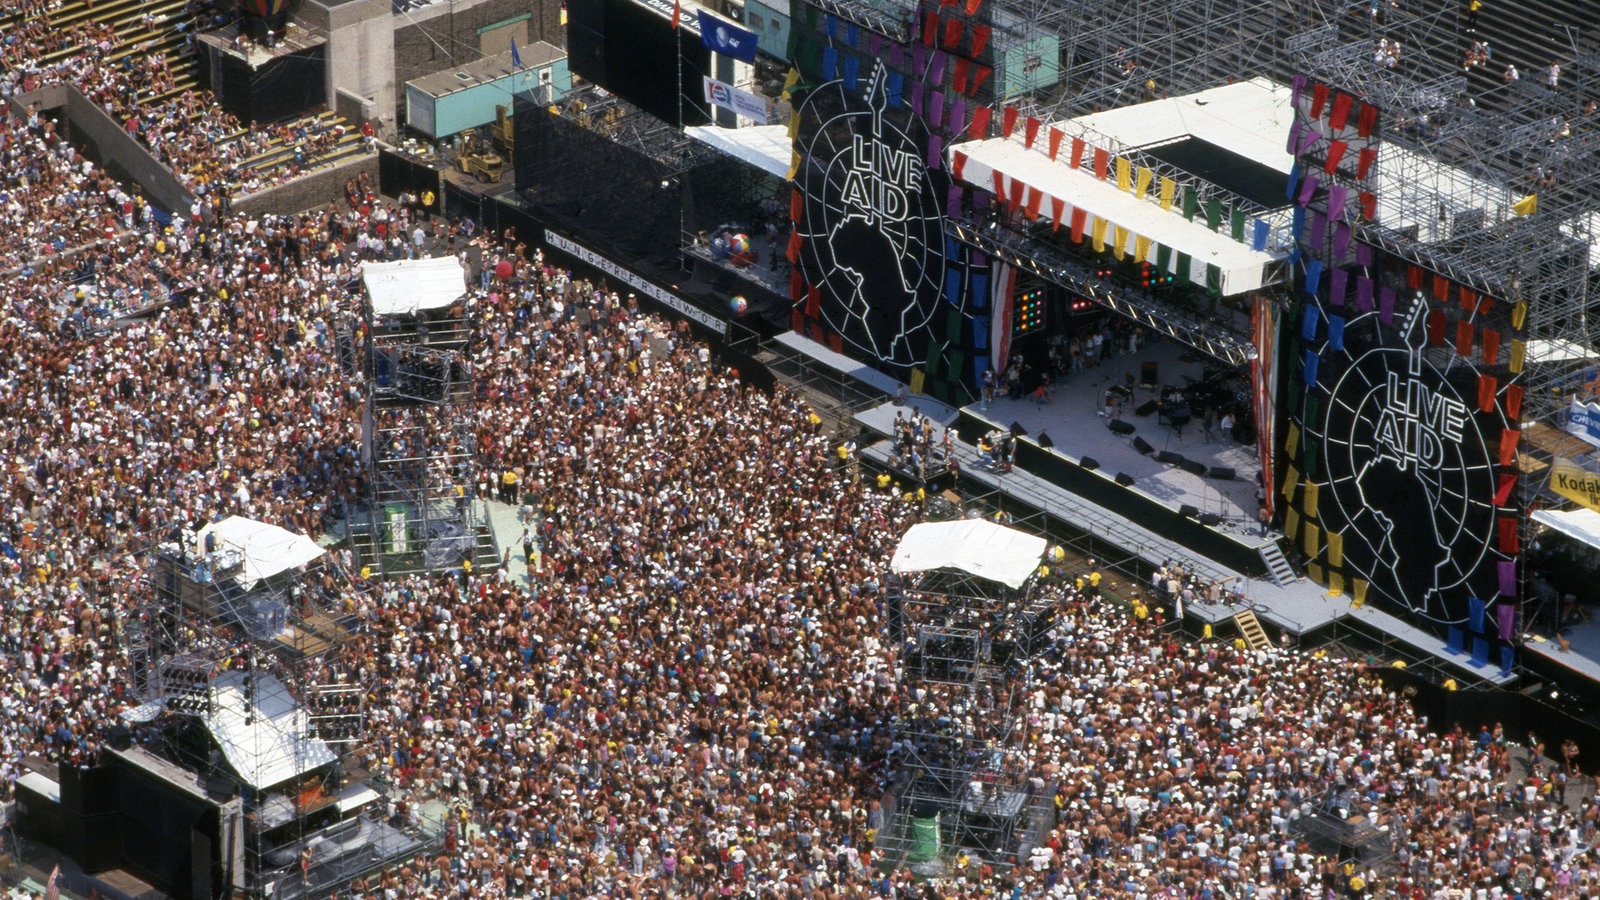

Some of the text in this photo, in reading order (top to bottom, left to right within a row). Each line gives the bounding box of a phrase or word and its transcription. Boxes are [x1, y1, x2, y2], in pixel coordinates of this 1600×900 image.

[853, 134, 922, 193] LIVE
[841, 170, 908, 222] AID
[547, 231, 620, 276] HUNGER
[629, 274, 676, 307] FREE
[1387, 371, 1465, 443] LIVE
[1374, 408, 1444, 470] AID
